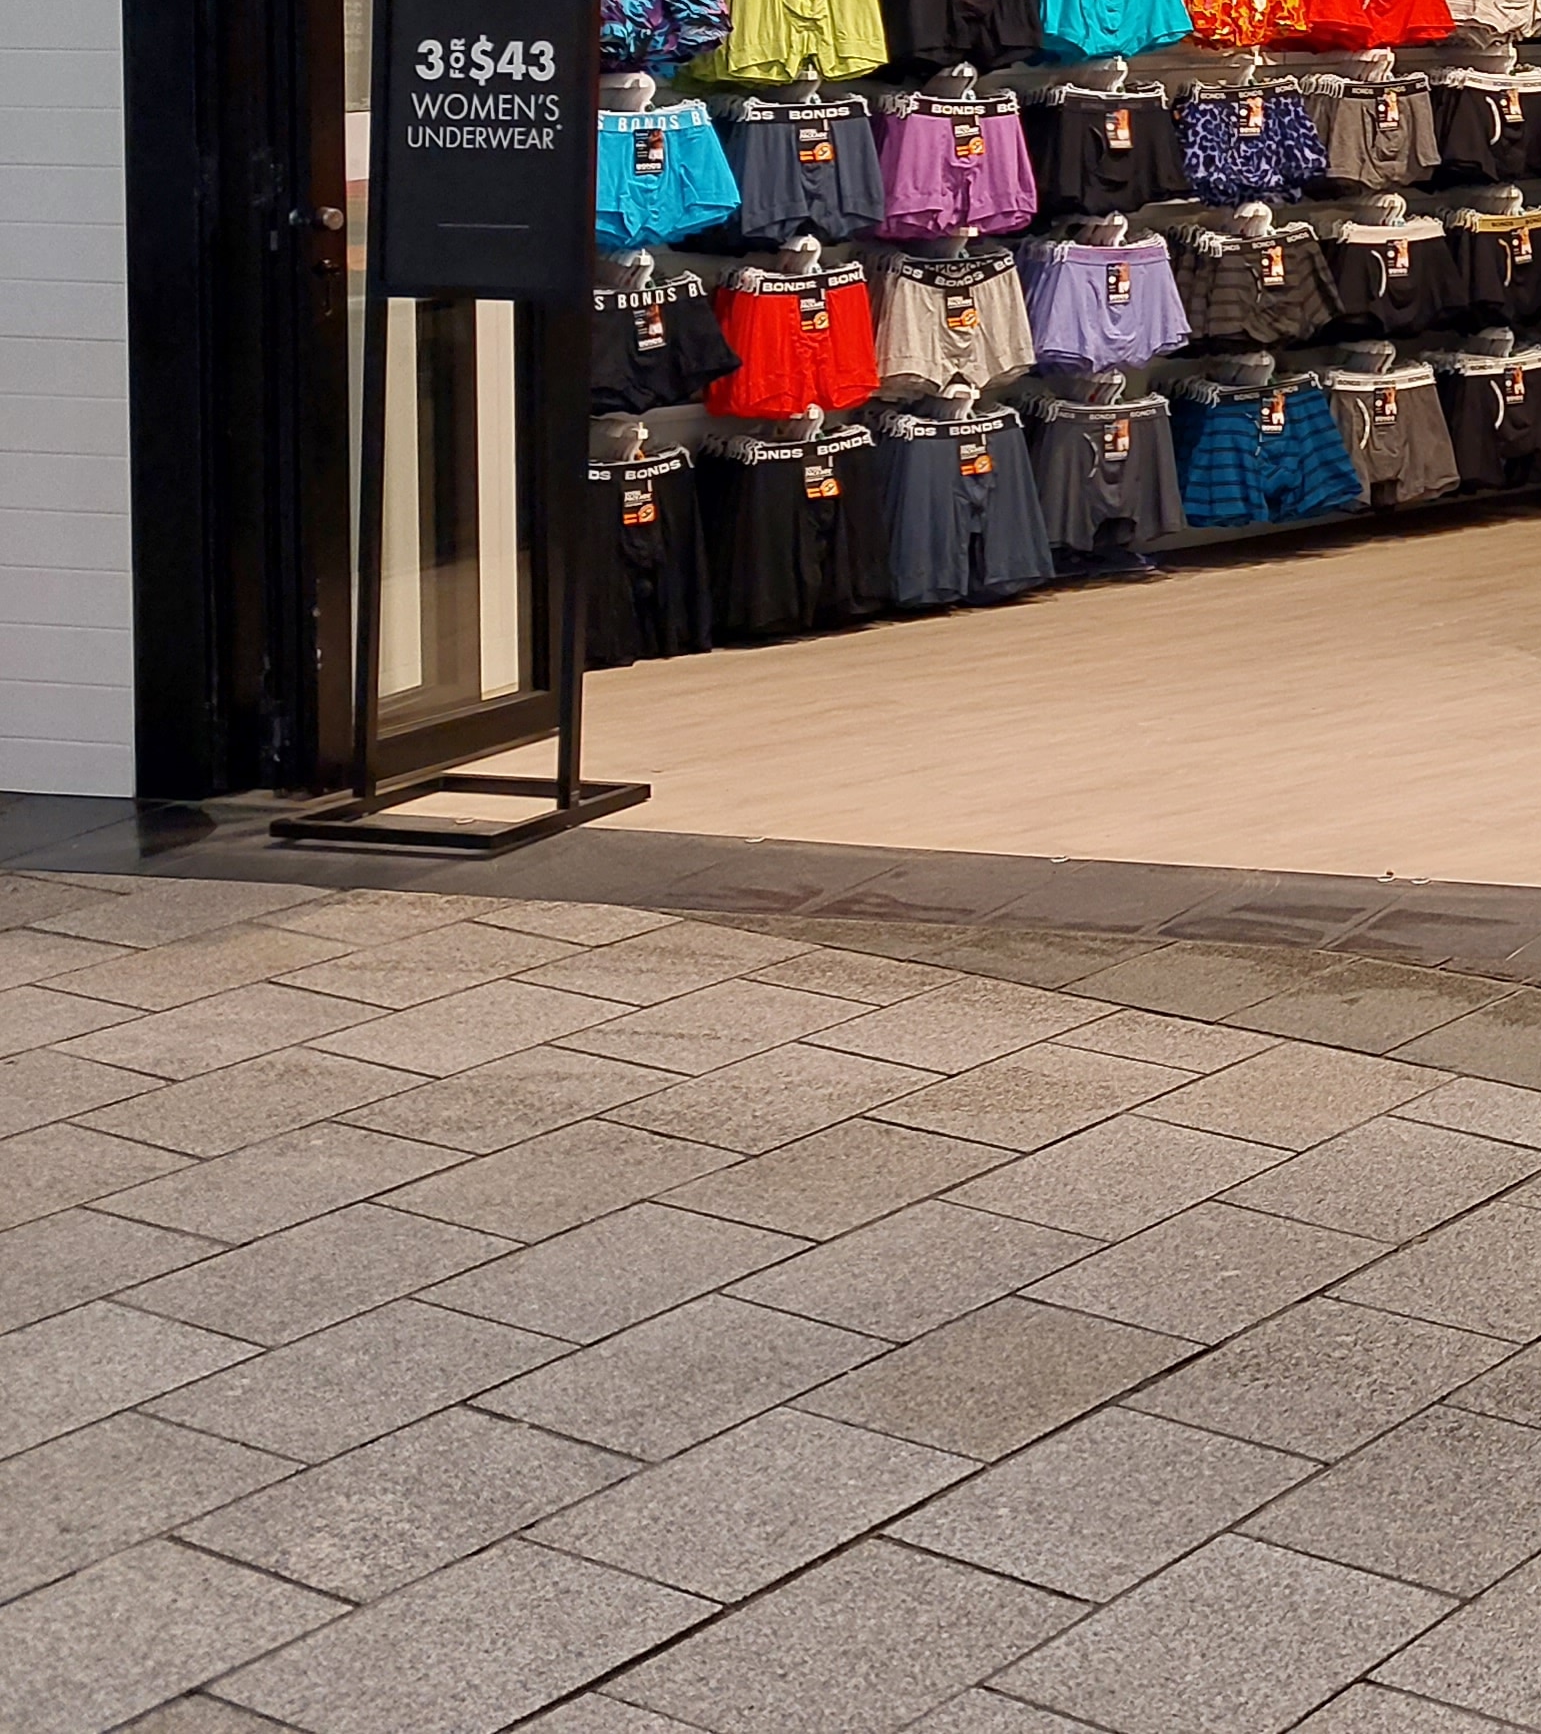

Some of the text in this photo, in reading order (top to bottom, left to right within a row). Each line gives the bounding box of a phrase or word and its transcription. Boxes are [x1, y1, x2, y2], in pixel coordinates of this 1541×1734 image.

[415, 35, 555, 86] 3 FOR $43
[411, 93, 560, 121] WOMEN'S
[788, 106, 850, 120] BONDS
[931, 104, 986, 116] BONDS
[618, 115, 679, 132] BONDS
[762, 279, 816, 292] BONDS
[934, 270, 984, 289] BONDS
[618, 287, 677, 309] BONDS
[949, 420, 1003, 437] BONDS
[817, 433, 872, 455] BONDS
[624, 459, 682, 481] BONDS
